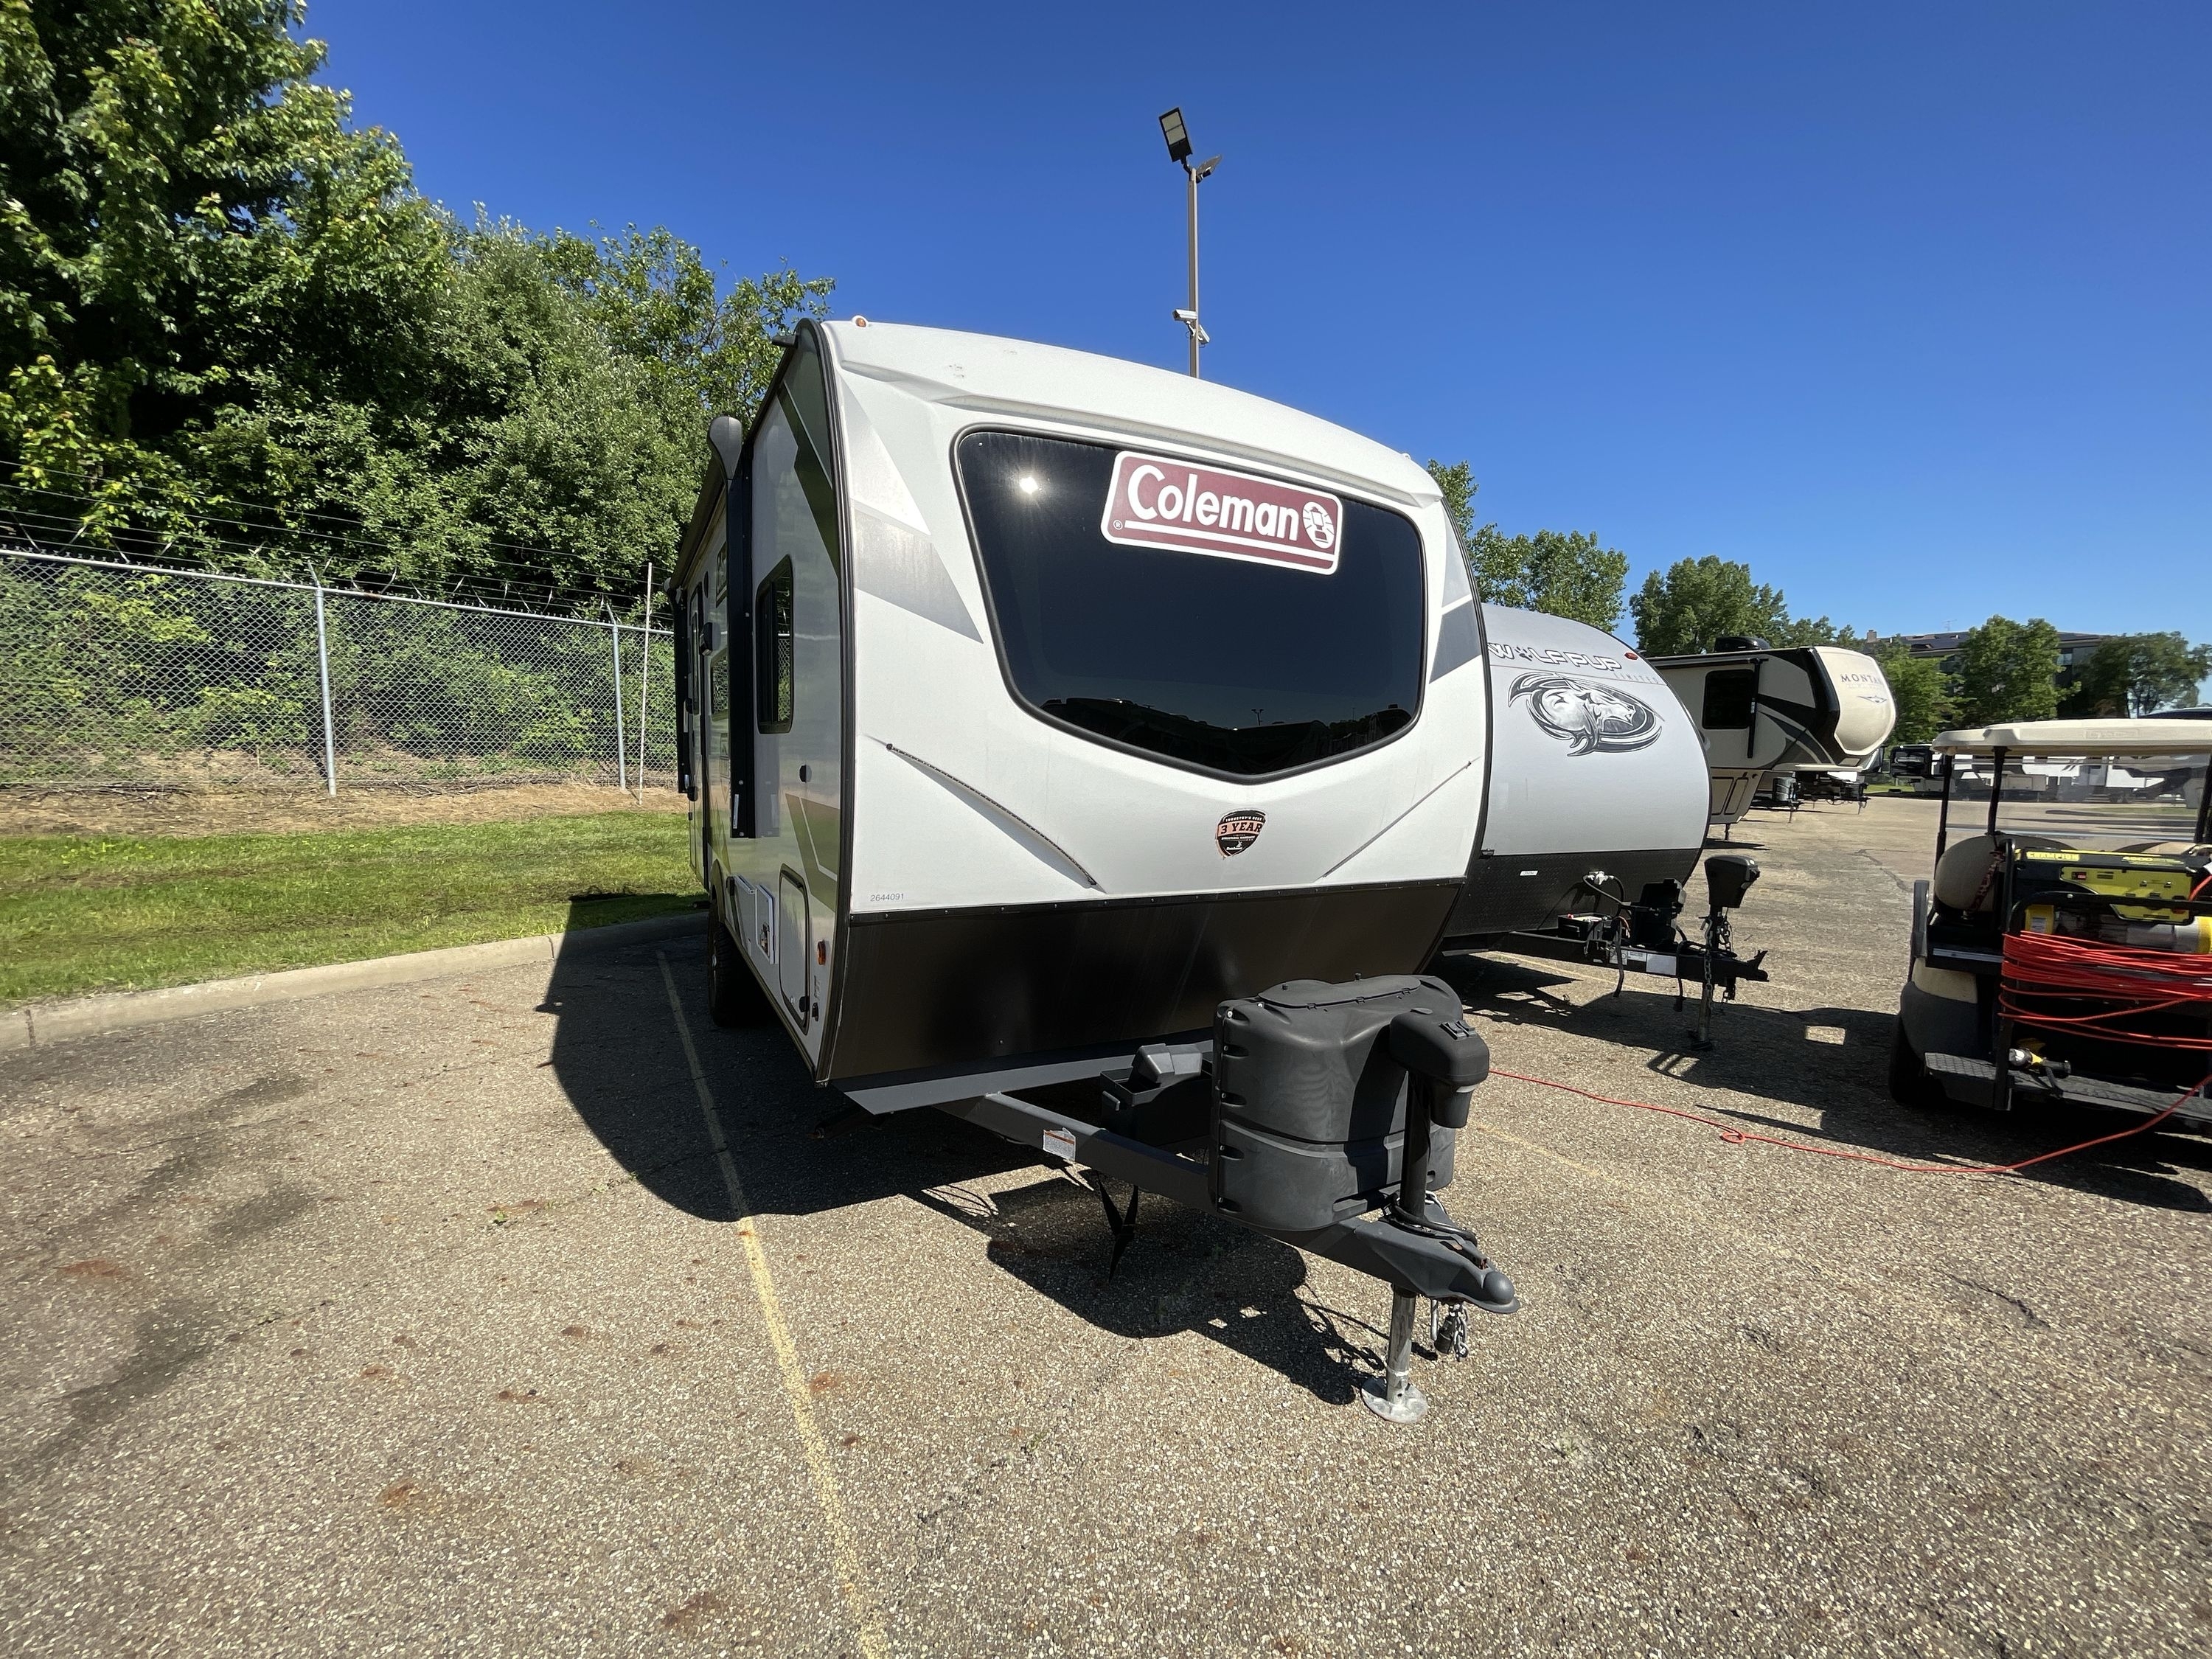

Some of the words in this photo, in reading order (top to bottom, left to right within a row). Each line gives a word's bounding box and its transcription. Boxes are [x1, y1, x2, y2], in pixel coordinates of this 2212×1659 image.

[1127, 464, 1300, 542] Coleman
[1563, 651, 1622, 672] PUP
[1220, 824, 1228, 834] 3
[1231, 821, 1263, 832] YEAR
[2025, 851, 2080, 862] CHAMPION
[870, 892, 904, 902] 2644091
